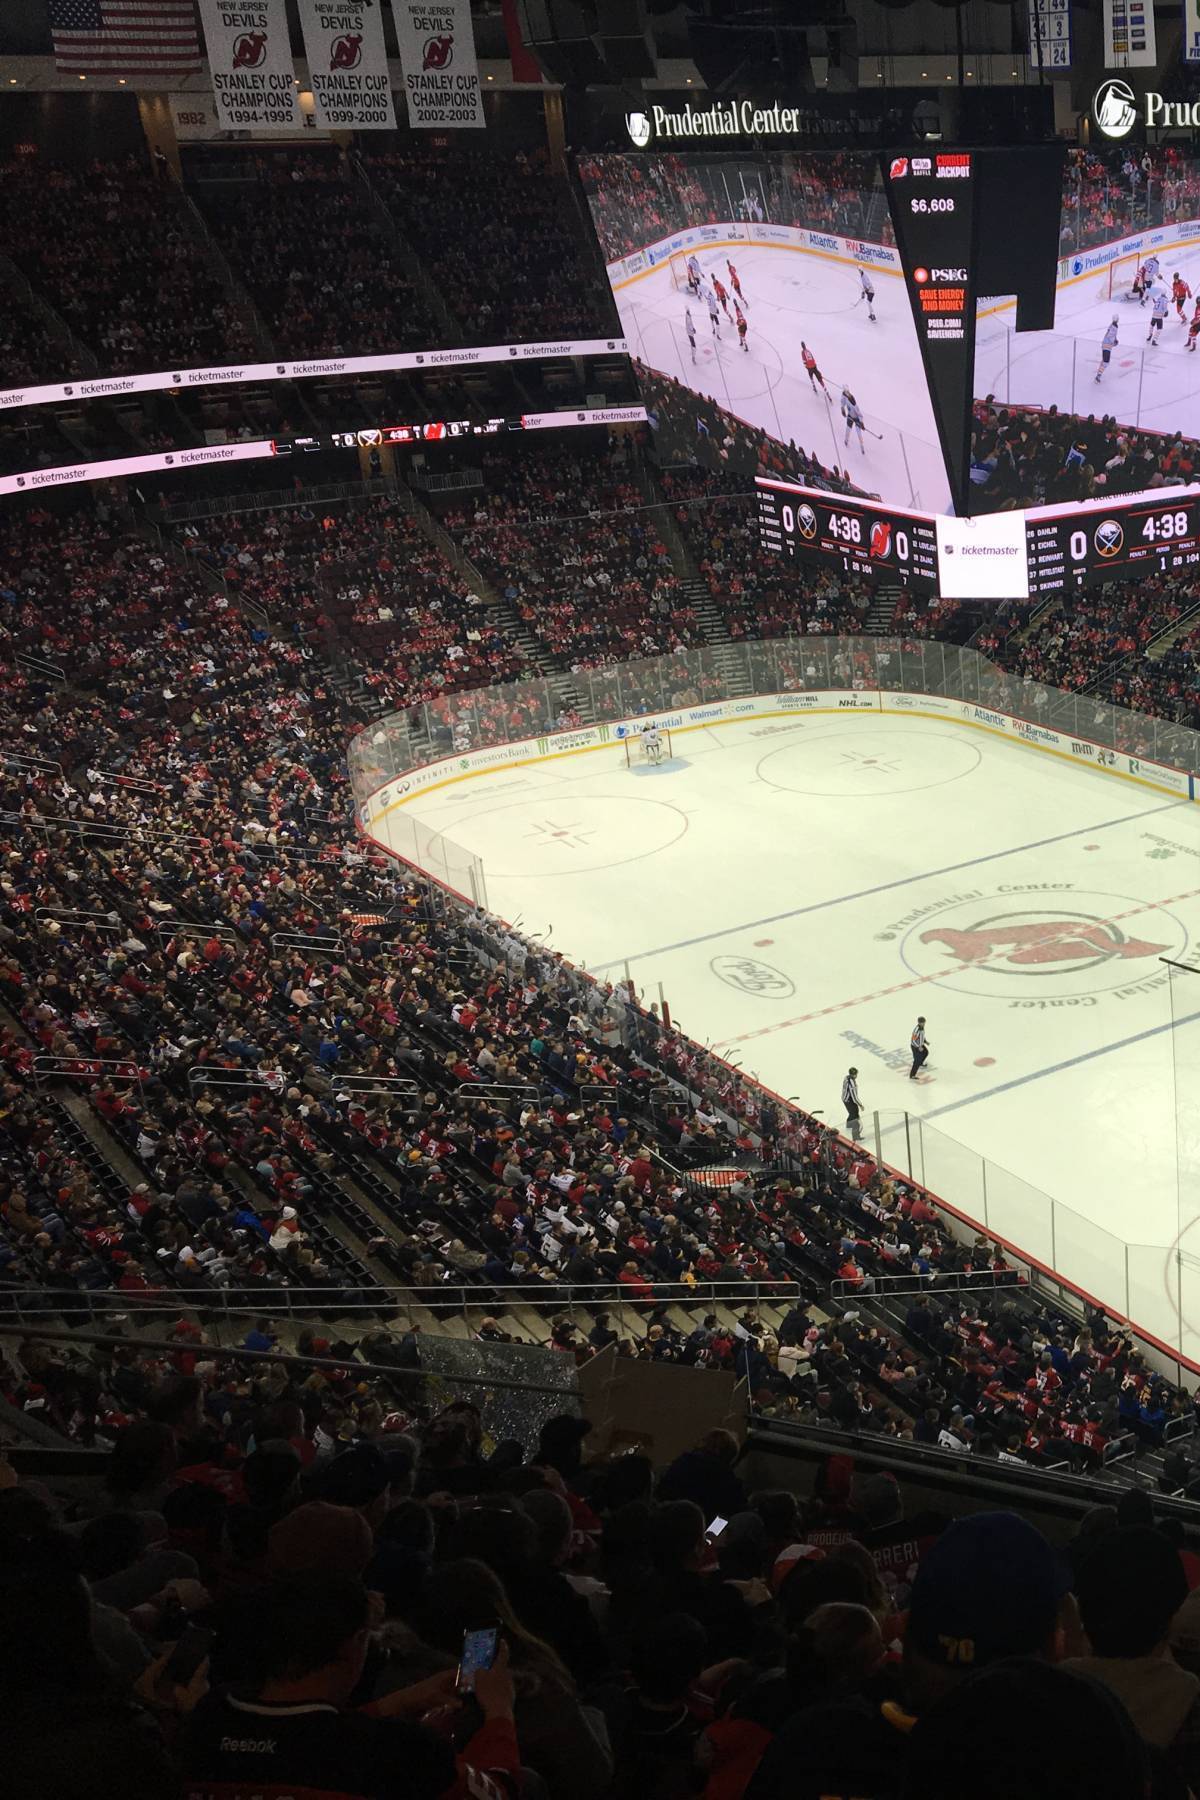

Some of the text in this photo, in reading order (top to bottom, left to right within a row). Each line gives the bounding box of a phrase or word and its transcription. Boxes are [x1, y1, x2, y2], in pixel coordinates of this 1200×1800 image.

[217, 2, 268, 11] NEW JERSEY
[315, 4, 364, 14] NEW JERSEY
[409, 5, 455, 15] NEW JERSEY
[223, 14, 267, 27] DEVILS
[322, 16, 363, 30] DEVILS
[414, 17, 454, 31] DEVILS
[1053, 50, 1066, 64] 24
[215, 74, 293, 89] STANLEY CUP
[313, 75, 388, 90] STANLEY CUP
[408, 74, 478, 89] STANLEY CUP
[222, 92, 293, 107] CHAMPIONS
[320, 92, 388, 108] CHAMPIONS
[412, 92, 477, 107] CHAMPIONS
[177, 112, 206, 125] 1982
[227, 110, 293, 122] 1994-1995
[326, 111, 387, 122] 1999-2000
[417, 110, 476, 121] 2002-2003
[652, 99, 799, 136] Prudential Center
[936, 166, 970, 178] JACKPOT
[911, 198, 954, 214] $6,608
[809, 233, 838, 251] Atlantic
[1085, 248, 1119, 269] Prudential
[931, 269, 967, 282] PSEG
[431, 351, 480, 363] ticketmaster
[524, 346, 571, 355] ticketmaster
[188, 370, 244, 382] ticketmaster
[293, 363, 345, 375] ticketmaster
[80, 380, 135, 394] ticketmaster
[592, 411, 641, 421] ticketmaster
[181, 449, 235, 463] ticketmaster
[32, 469, 87, 485] ticketmaster
[783, 505, 794, 532] 0
[829, 514, 861, 543] 4:38
[1037, 527, 1057, 536] DAHLIN
[1142, 512, 1188, 541] 4:38
[896, 531, 909, 560] 0
[962, 545, 1019, 555] ticketmaster
[1070, 531, 1087, 560] 0
[1178, 541, 1195, 550] PENALTY
[1129, 550, 1147, 559] PENALTY
[1186, 553, 1200, 564] 1:04
[843, 557, 848, 570] 1
[1160, 557, 1166, 570] 1
[1040, 580, 1063, 590] SKINNER
[689, 703, 754, 721] Walmart com
[974, 708, 1005, 727] Atlantic
[1012, 720, 1059, 743] RWJBarnabas
[412, 765, 453, 786] INFINITI
[886, 882, 1075, 931] Prudential Center
[722, 962, 787, 990] Ford
[1008, 996, 1098, 1009] Center
[220, 1737, 278, 1753] Reebok
